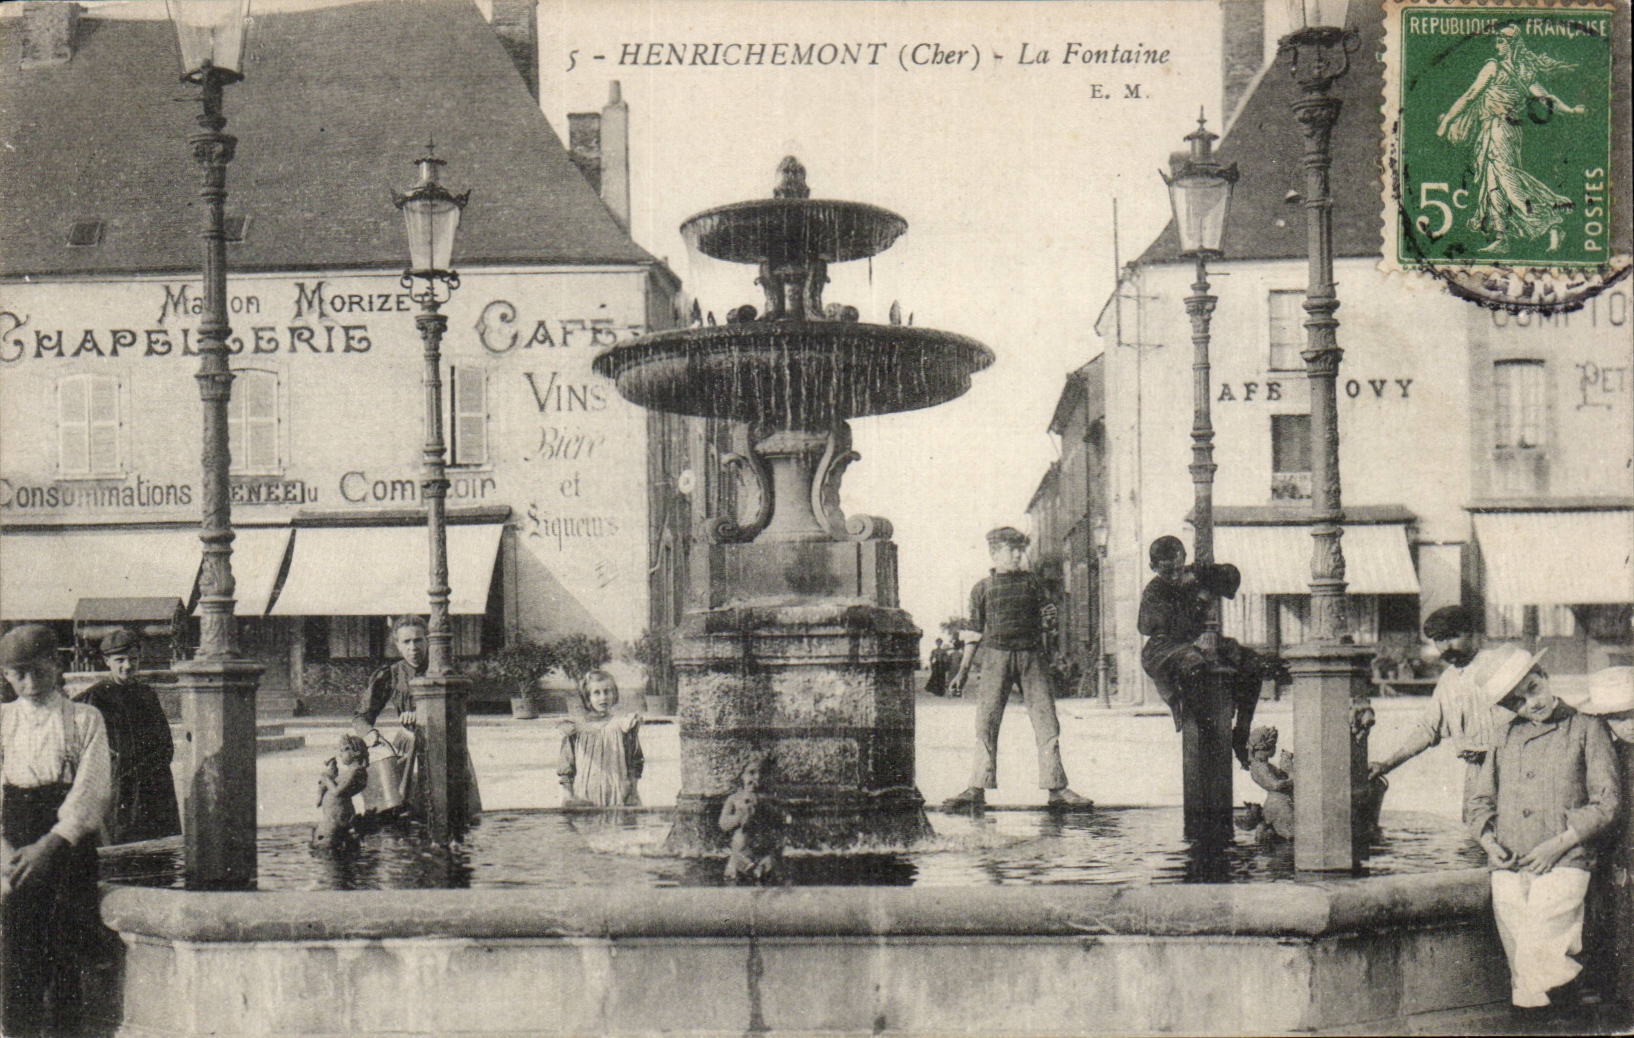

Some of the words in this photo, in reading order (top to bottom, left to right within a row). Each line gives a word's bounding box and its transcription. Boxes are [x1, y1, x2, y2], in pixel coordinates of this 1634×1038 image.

[1526, 17, 1607, 38] FRANÇAISE
[1584, 167, 1605, 251] POSTES
[158, 283, 261, 325] Maon
[339, 471, 497, 506] Comoir
